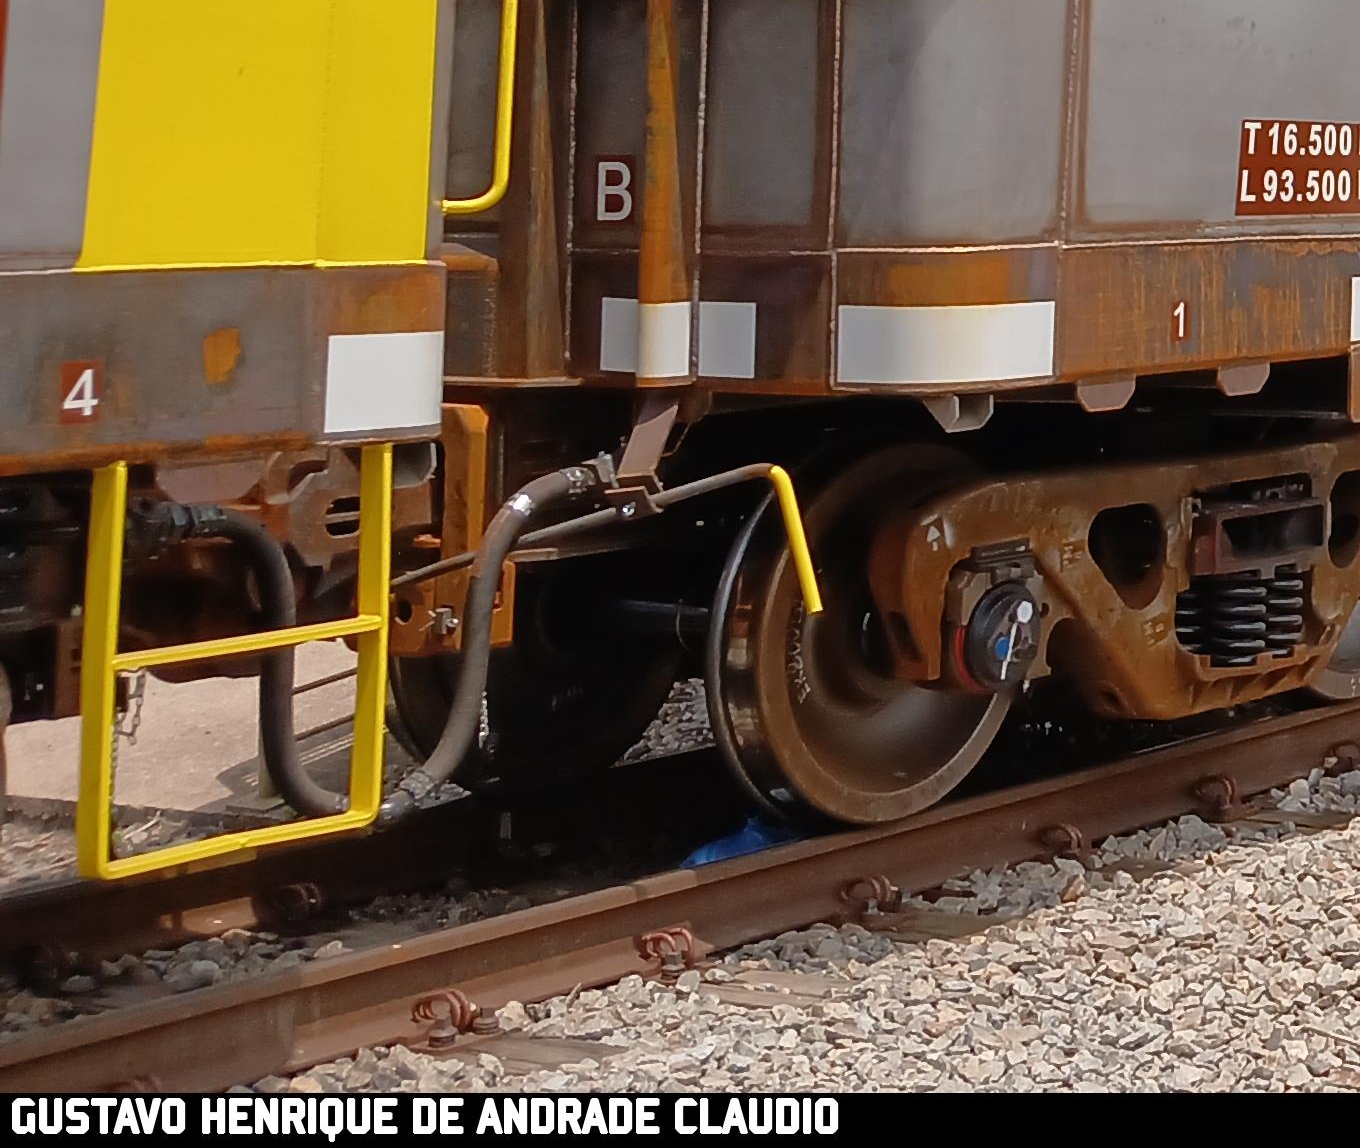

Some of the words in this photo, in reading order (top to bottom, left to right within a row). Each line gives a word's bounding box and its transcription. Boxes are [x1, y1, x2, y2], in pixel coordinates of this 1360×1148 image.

[1244, 121, 1262, 154] T
[1268, 122, 1352, 156] 16.500
[597, 161, 632, 221] B
[1240, 169, 1257, 202] L
[1262, 169, 1351, 202] 93.500
[1173, 301, 1185, 338] 1
[63, 369, 98, 416] 4
